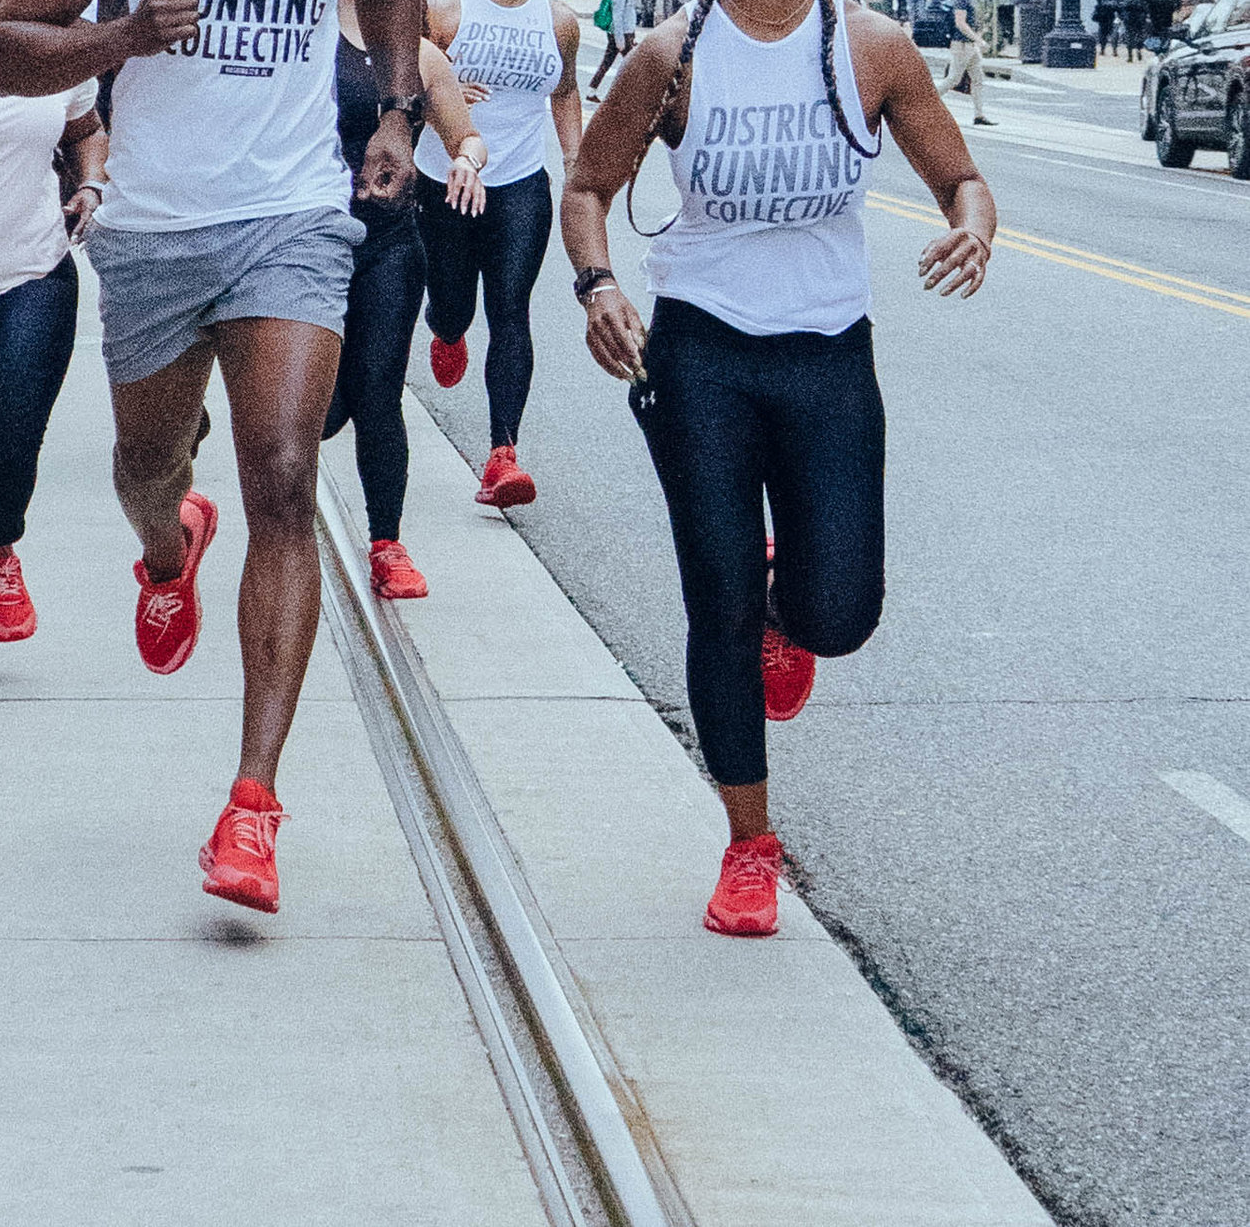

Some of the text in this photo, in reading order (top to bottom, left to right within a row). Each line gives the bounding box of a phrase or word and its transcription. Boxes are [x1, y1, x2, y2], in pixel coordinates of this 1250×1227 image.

[467, 22, 545, 49] DISTRICT
[453, 42, 557, 76] RUNNING
[458, 67, 547, 92] COLLECTIVE
[690, 142, 862, 197] RUNNING
[705, 190, 854, 223] COLLECTIVE
